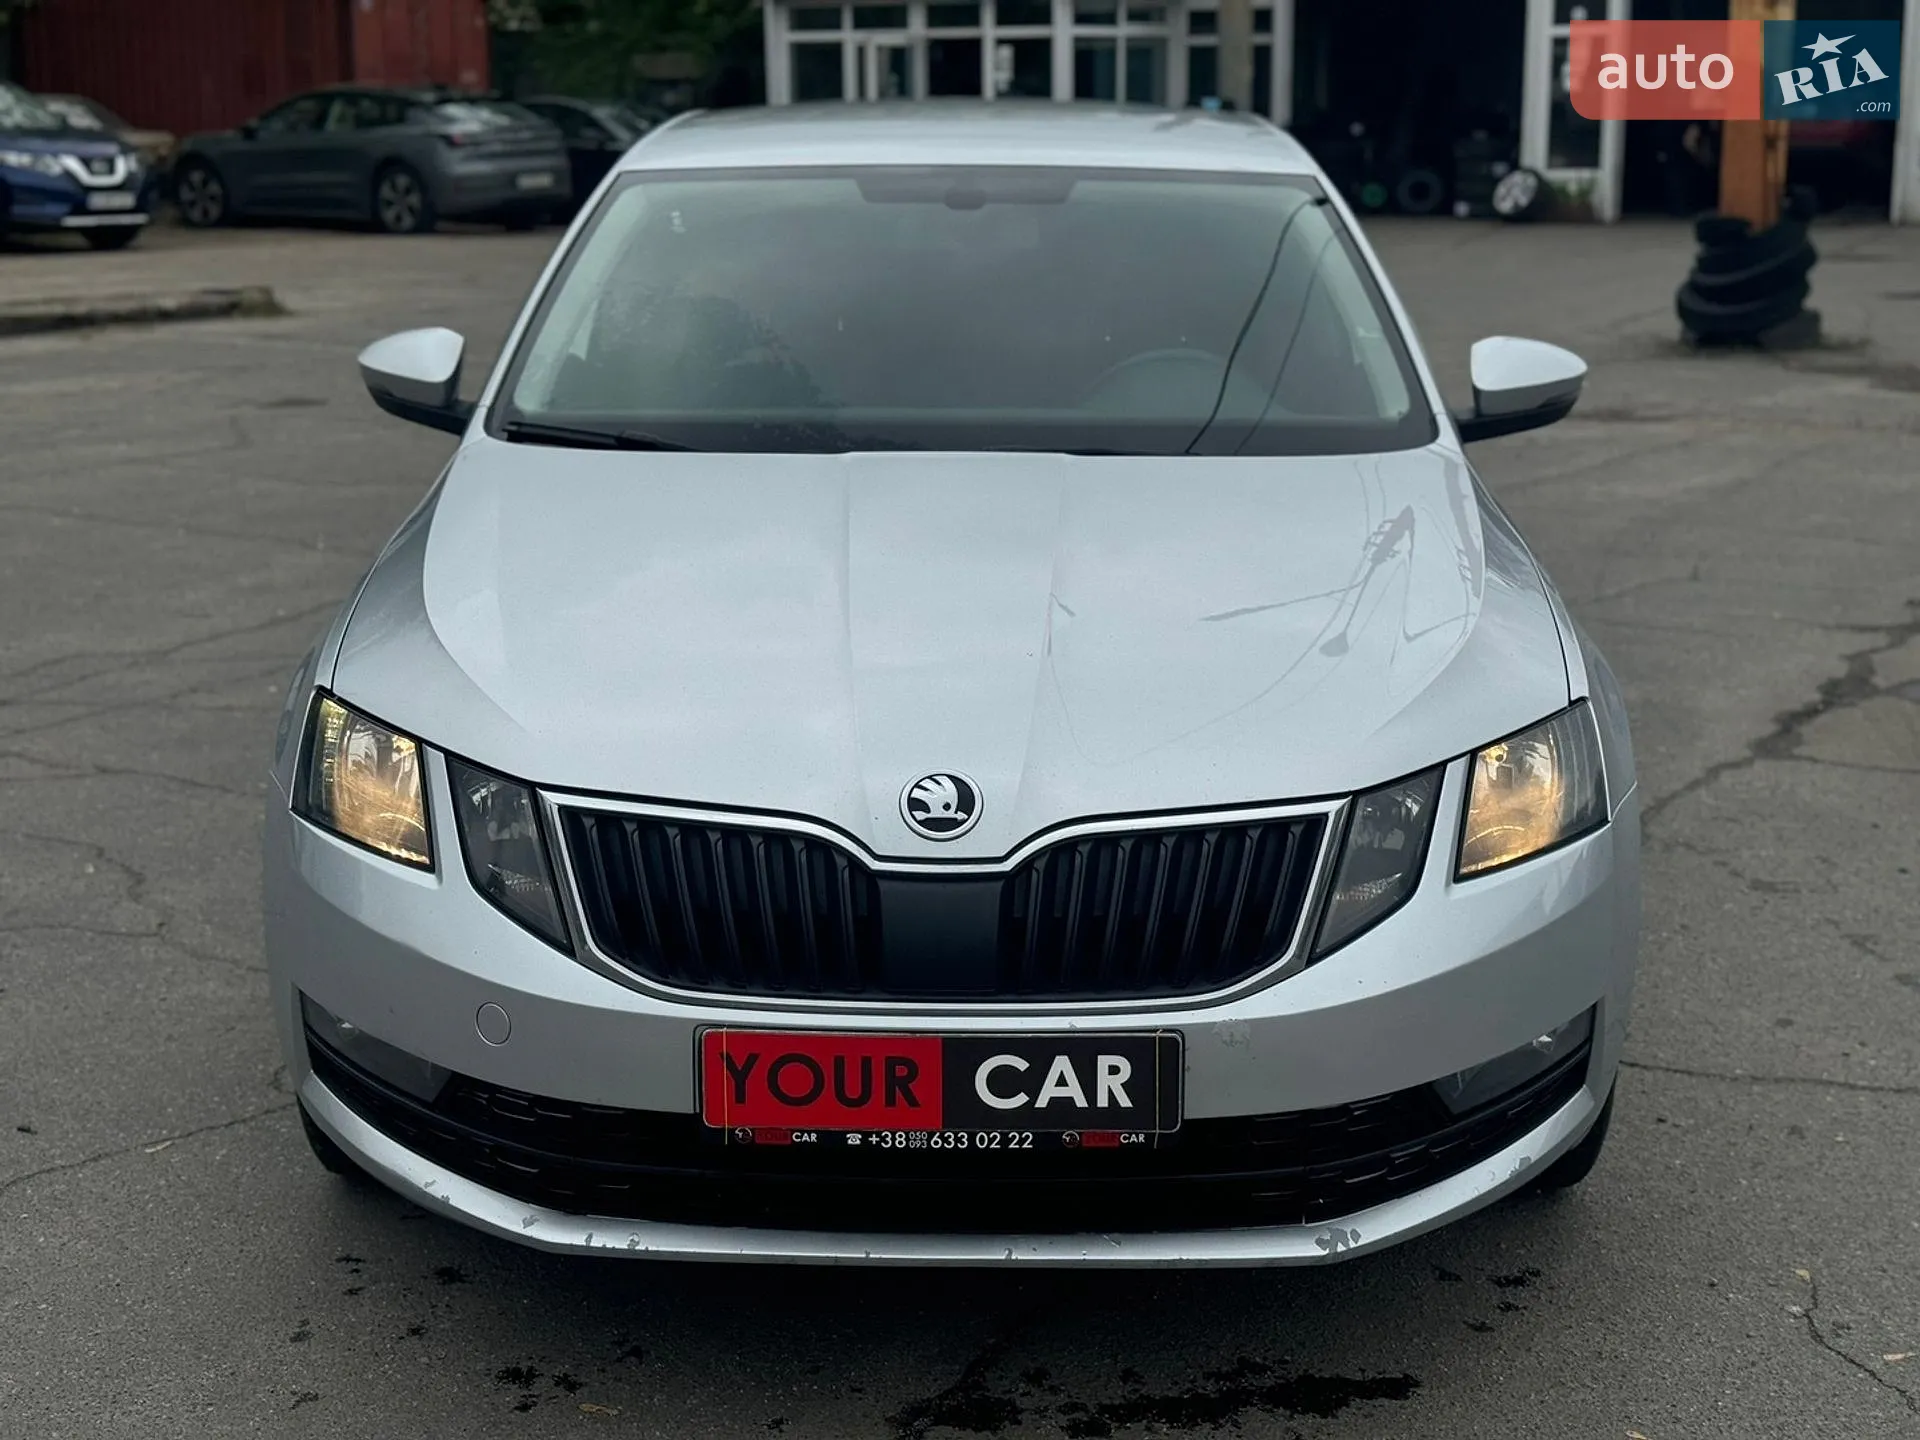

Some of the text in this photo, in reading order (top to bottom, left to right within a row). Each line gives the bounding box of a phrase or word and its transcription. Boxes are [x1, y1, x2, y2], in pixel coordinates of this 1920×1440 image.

[719, 1052, 1133, 1109] YOUR CAR
[792, 1132, 817, 1142] CAR
[868, 1131, 906, 1148] +38
[930, 1131, 968, 1148] 633
[976, 1131, 1001, 1148] 02
[1008, 1131, 1033, 1148] 22
[1120, 1133, 1145, 1143] CAR
